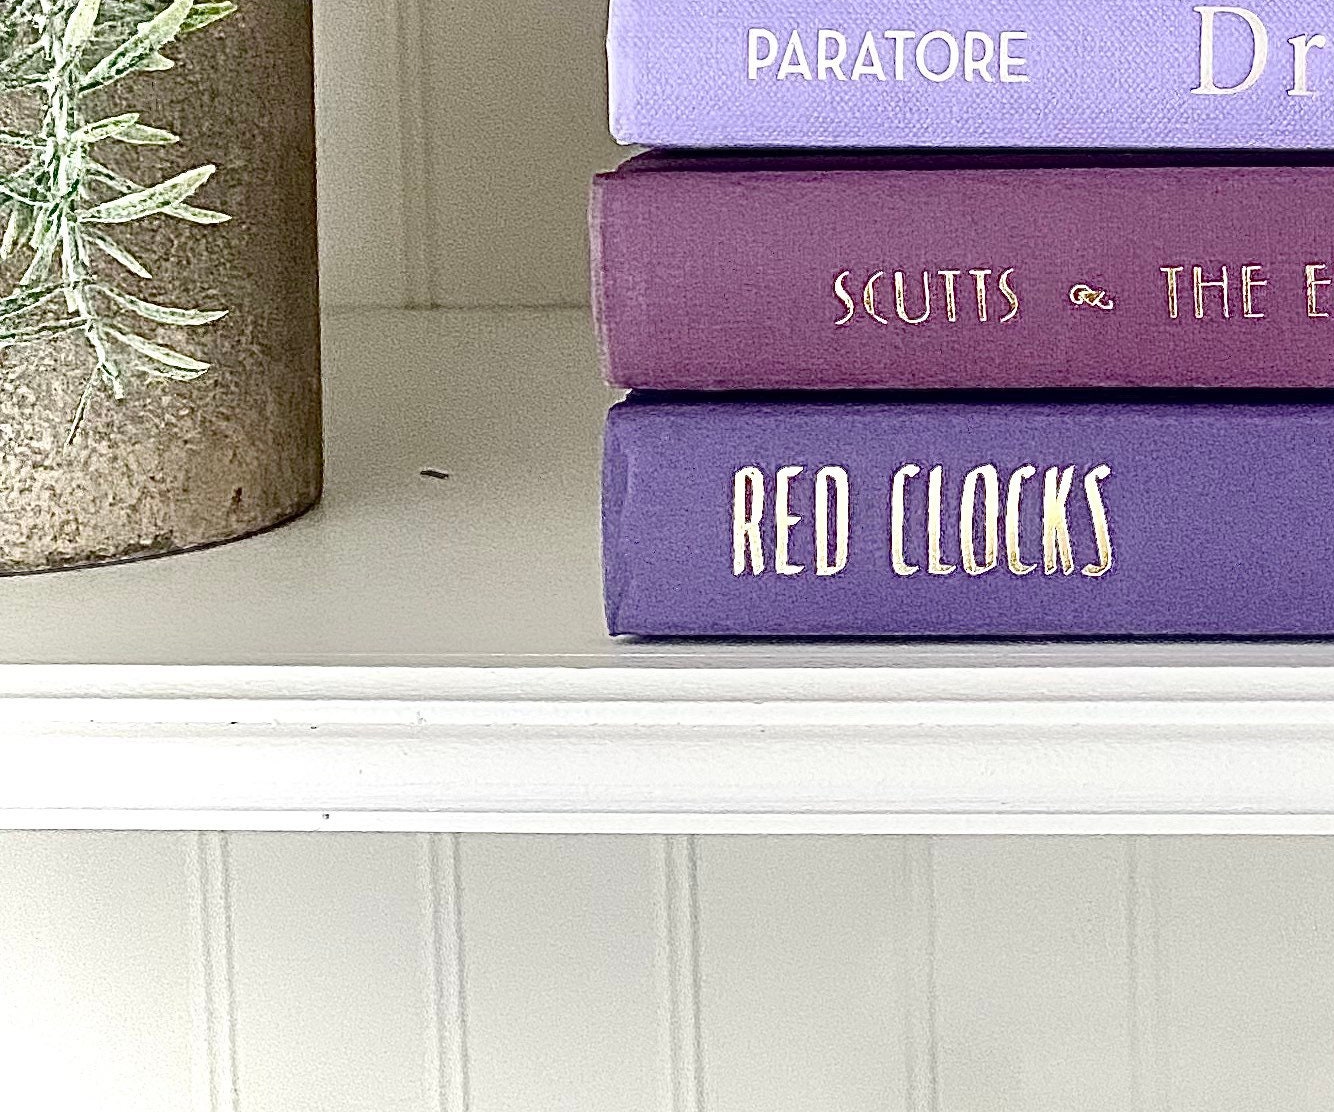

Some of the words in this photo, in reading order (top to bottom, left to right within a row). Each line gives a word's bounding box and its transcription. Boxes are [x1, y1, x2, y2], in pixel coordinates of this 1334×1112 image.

[747, 28, 1030, 83] PARATORE
[834, 268, 1019, 325] SCUTTS
[1159, 265, 1268, 319] THE
[733, 466, 849, 576] RED
[891, 464, 1113, 577] CLOCKS
